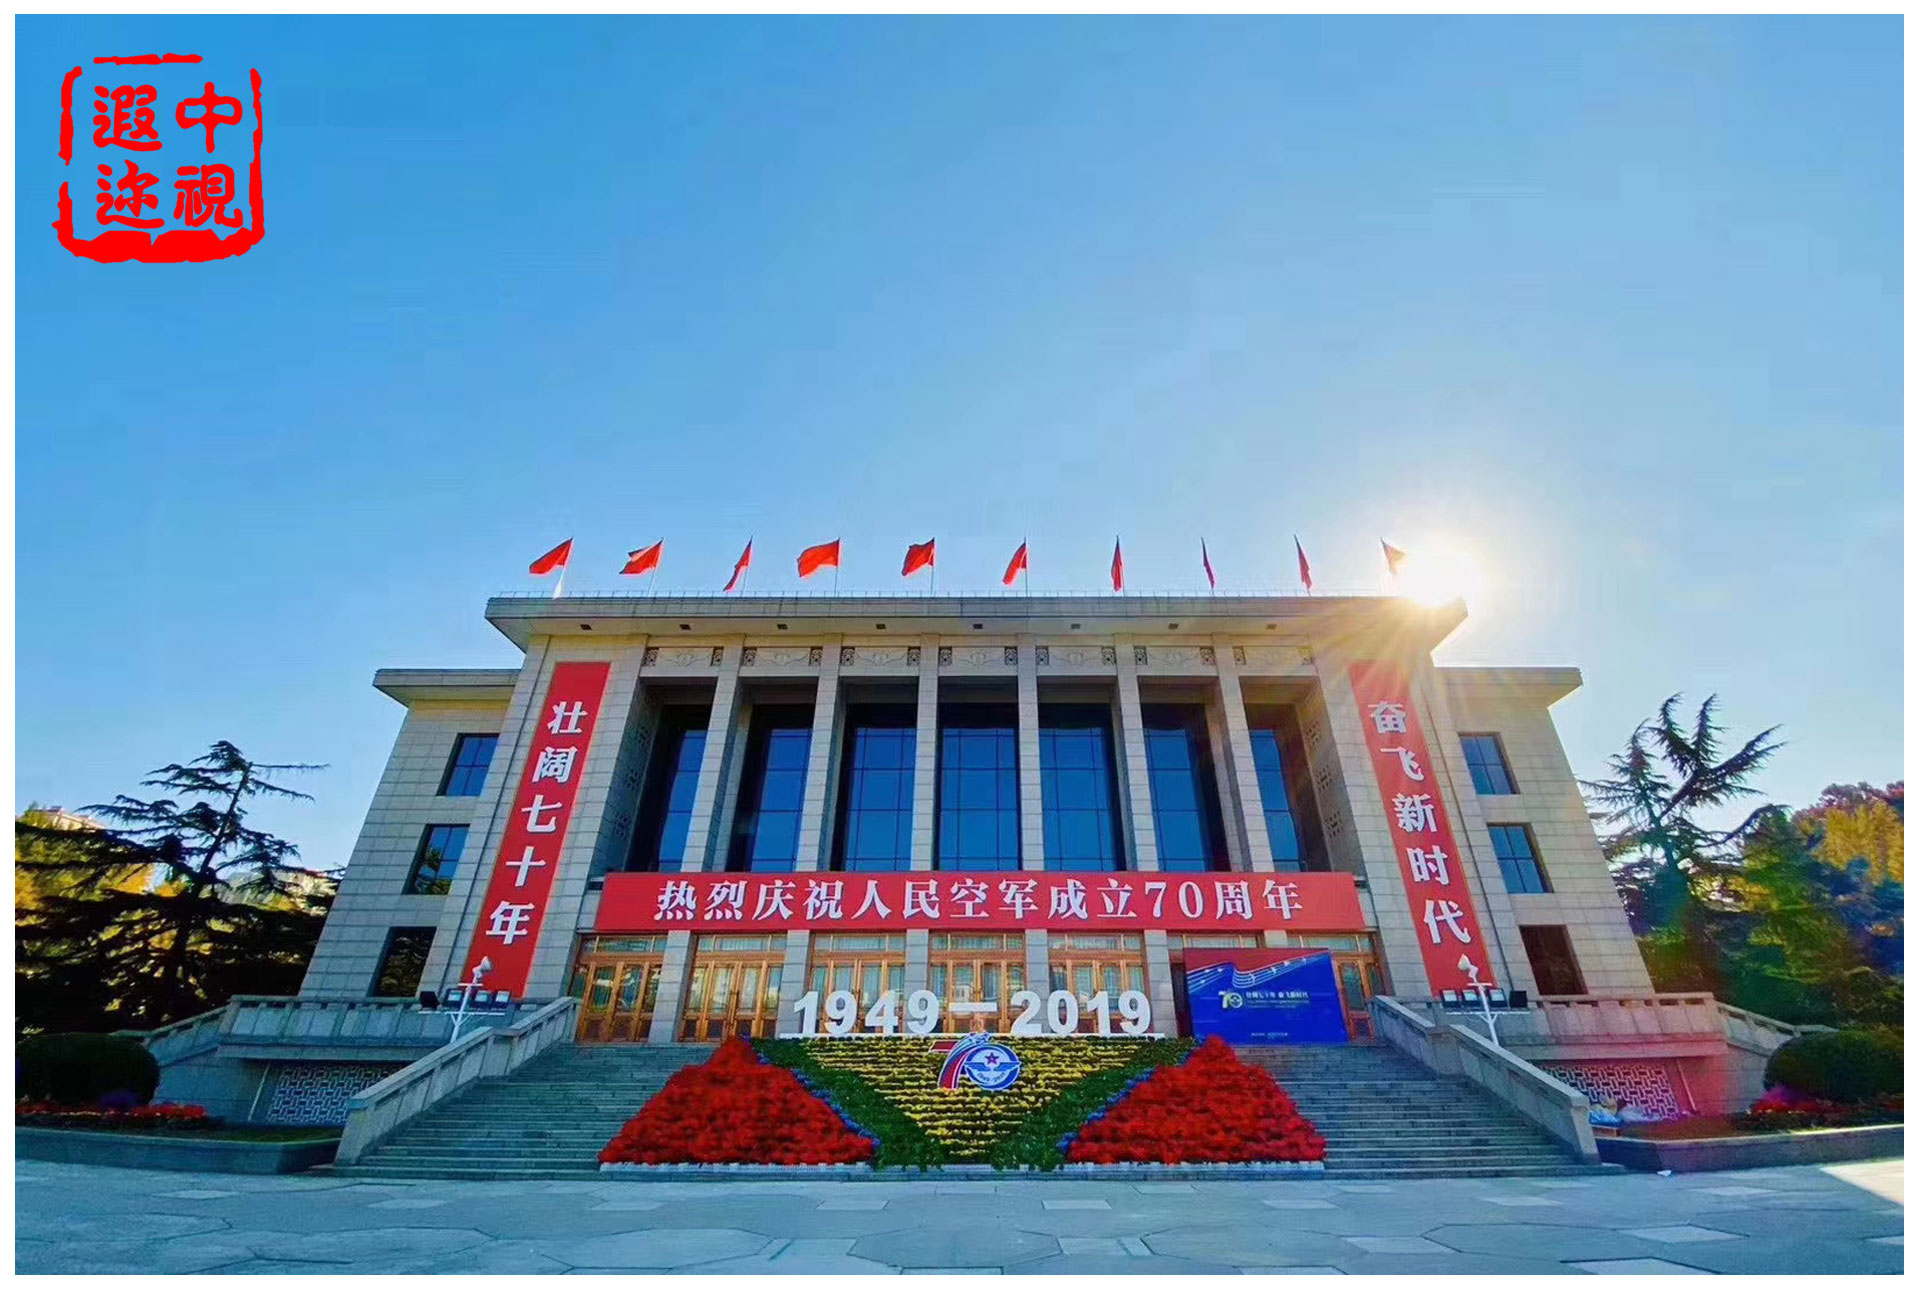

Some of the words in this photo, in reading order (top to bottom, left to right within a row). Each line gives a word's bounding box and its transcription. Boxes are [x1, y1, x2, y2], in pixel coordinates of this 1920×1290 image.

[486, 701, 588, 945] 壮阔七十年
[654, 878, 1303, 920] 热烈庆祝人民空军成立70周年
[1368, 700, 1471, 944] 奋飞新时代
